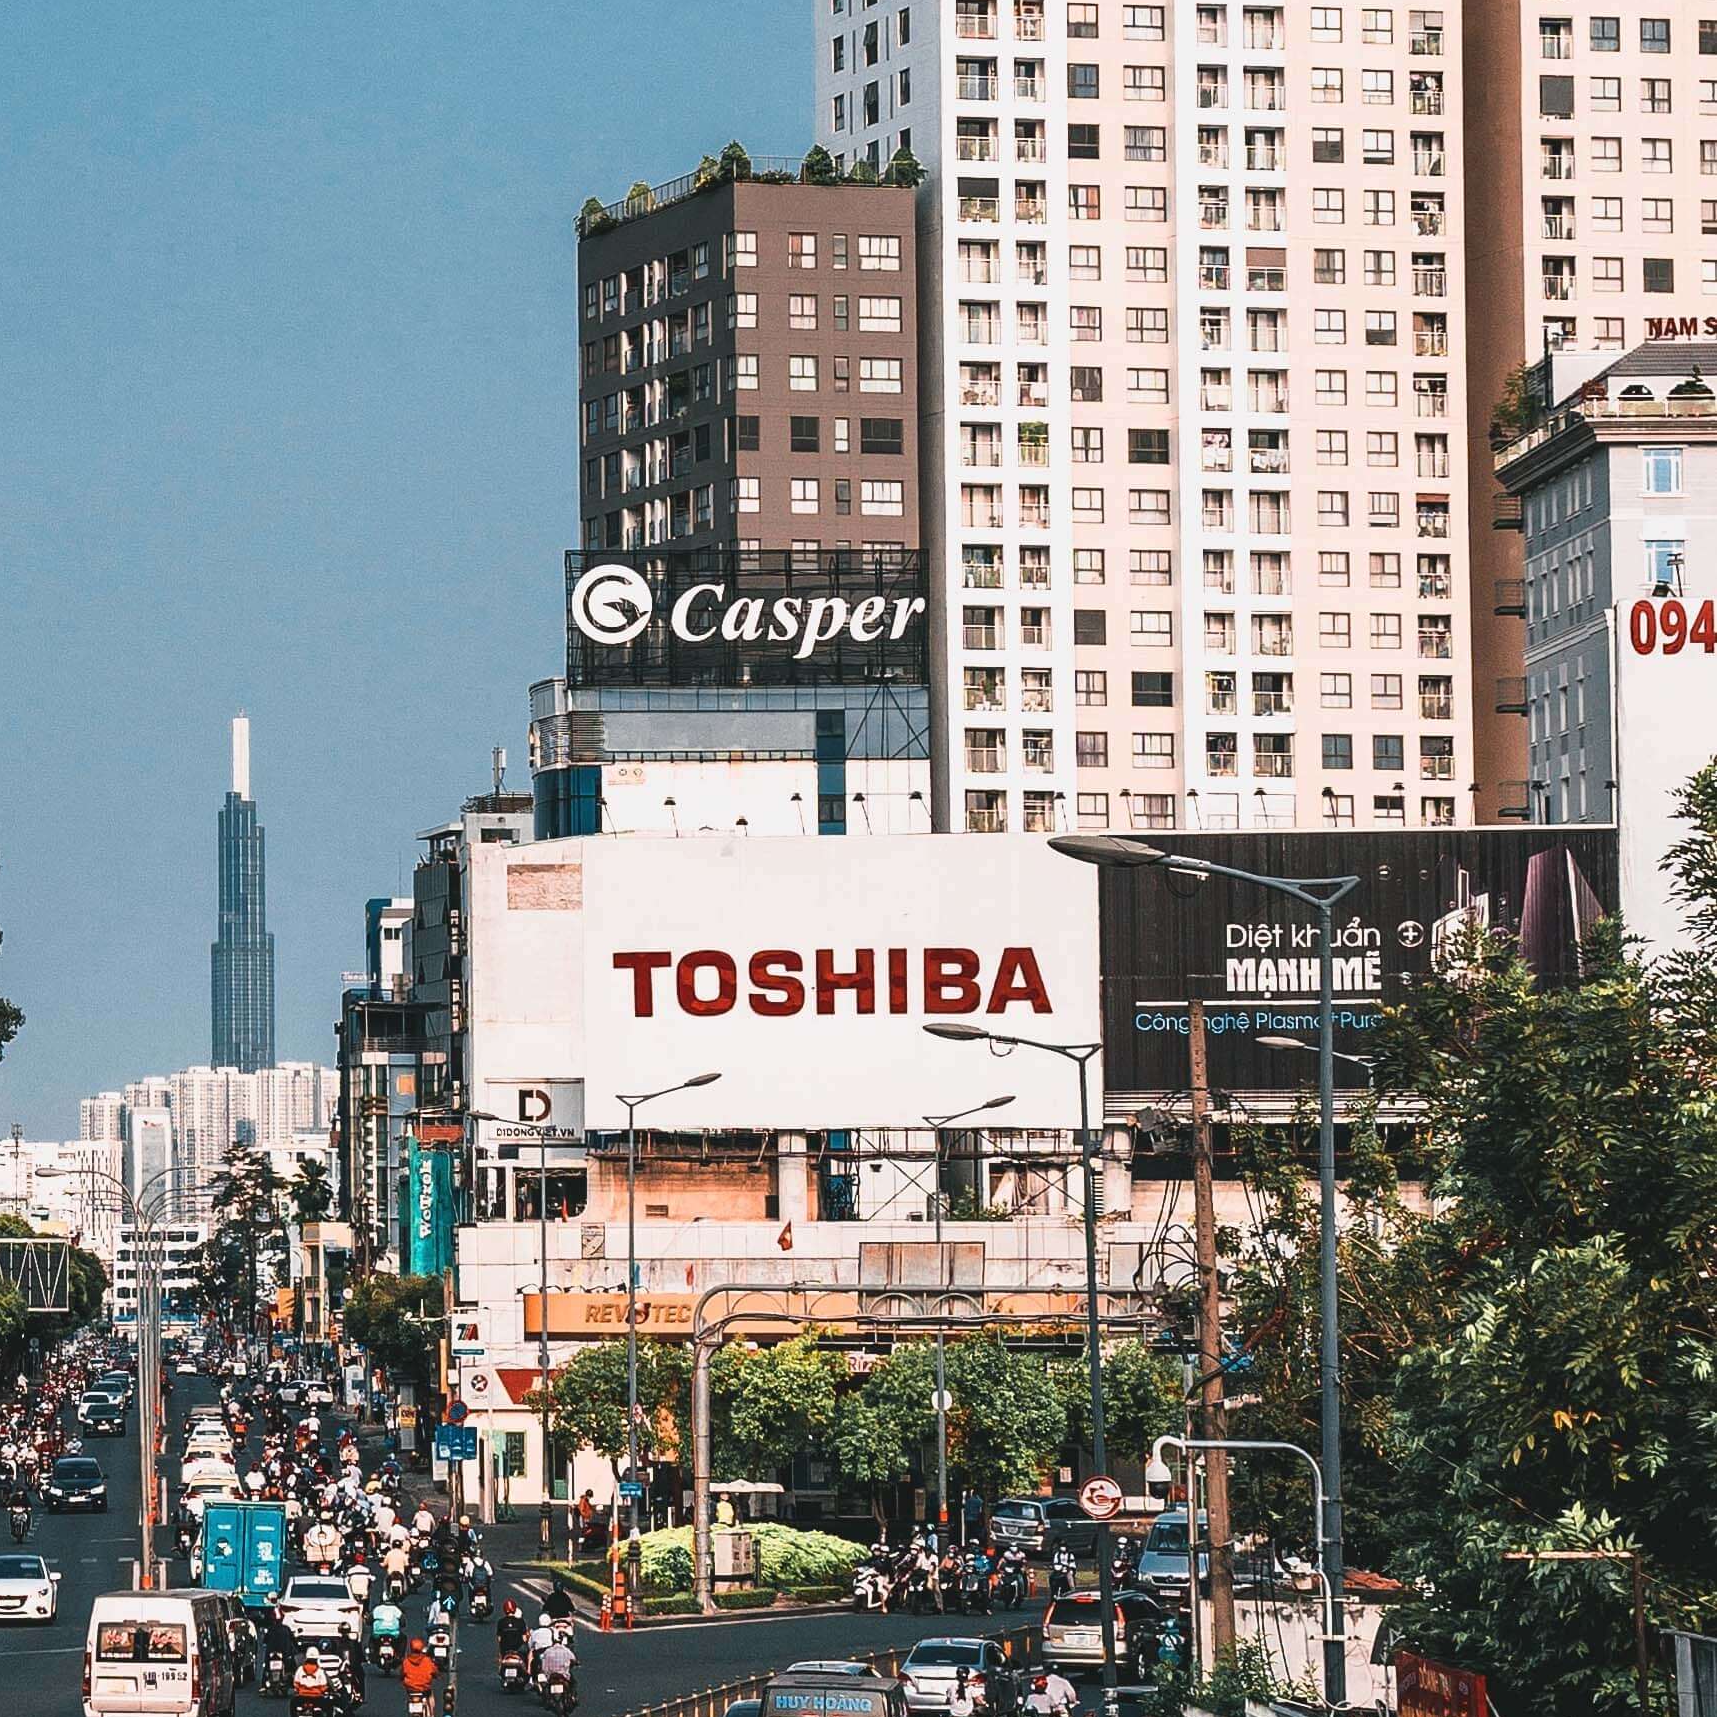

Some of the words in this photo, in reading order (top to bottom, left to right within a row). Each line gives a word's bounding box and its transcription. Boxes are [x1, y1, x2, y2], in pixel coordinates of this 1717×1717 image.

[1648, 317, 1698, 336] NAM
[670, 583, 926, 660] Casper
[1629, 600, 1717, 656] 094
[1226, 923, 1283, 953] Diệt
[612, 946, 1054, 1019] TOSHIBA
[1226, 957, 1321, 999] MẠNH
[1331, 950, 1382, 991] MẼ
[1135, 1012, 1191, 1034] Công
[1202, 1011, 1250, 1034] nghệ
[496, 1128, 575, 1137] DIDONGVET.VN
[775, 1694, 811, 1710] HUY
[812, 1693, 873, 1712] HOÀNG
